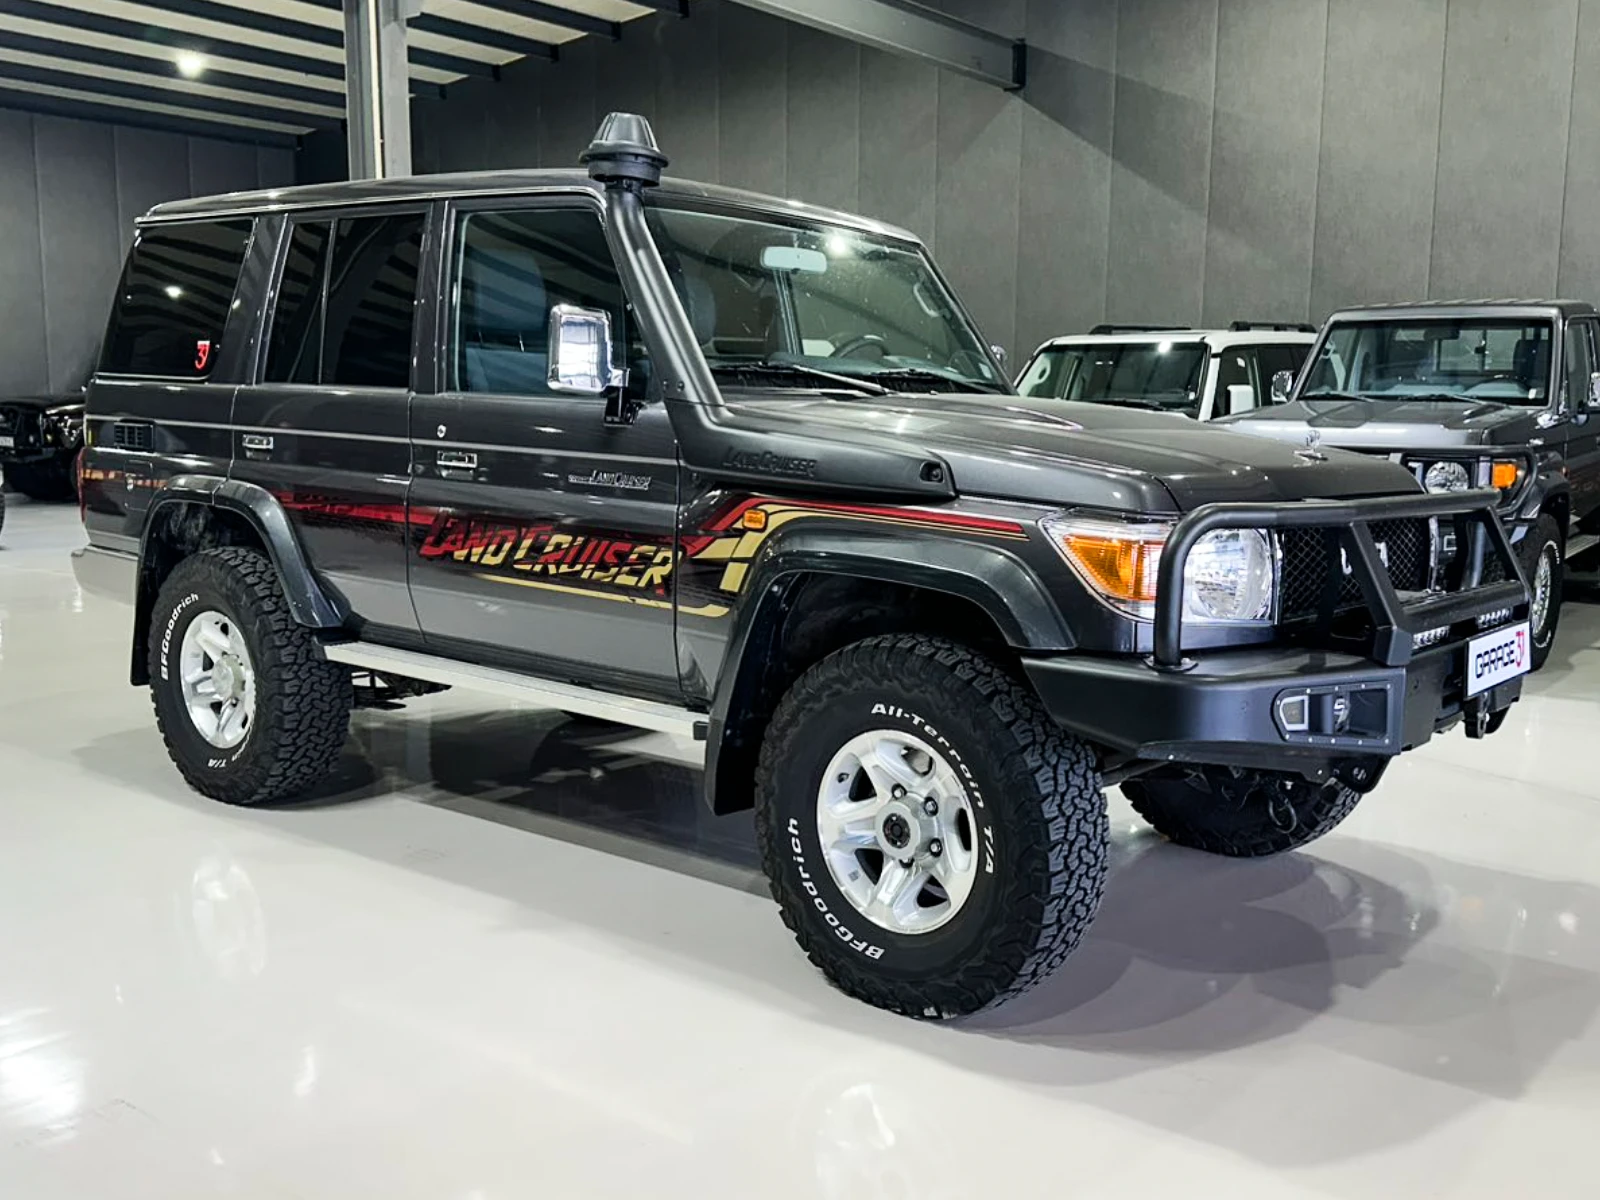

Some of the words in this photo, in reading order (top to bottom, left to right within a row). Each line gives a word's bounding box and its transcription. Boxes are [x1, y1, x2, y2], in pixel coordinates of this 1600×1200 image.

[419, 508, 517, 566] LAND
[513, 525, 682, 596] CRUISER
[160, 593, 199, 681] BFGoodrich
[871, 703, 984, 809] All-Terrain
[983, 825, 995, 874] T/A
[787, 817, 886, 960] BFGoodrich
